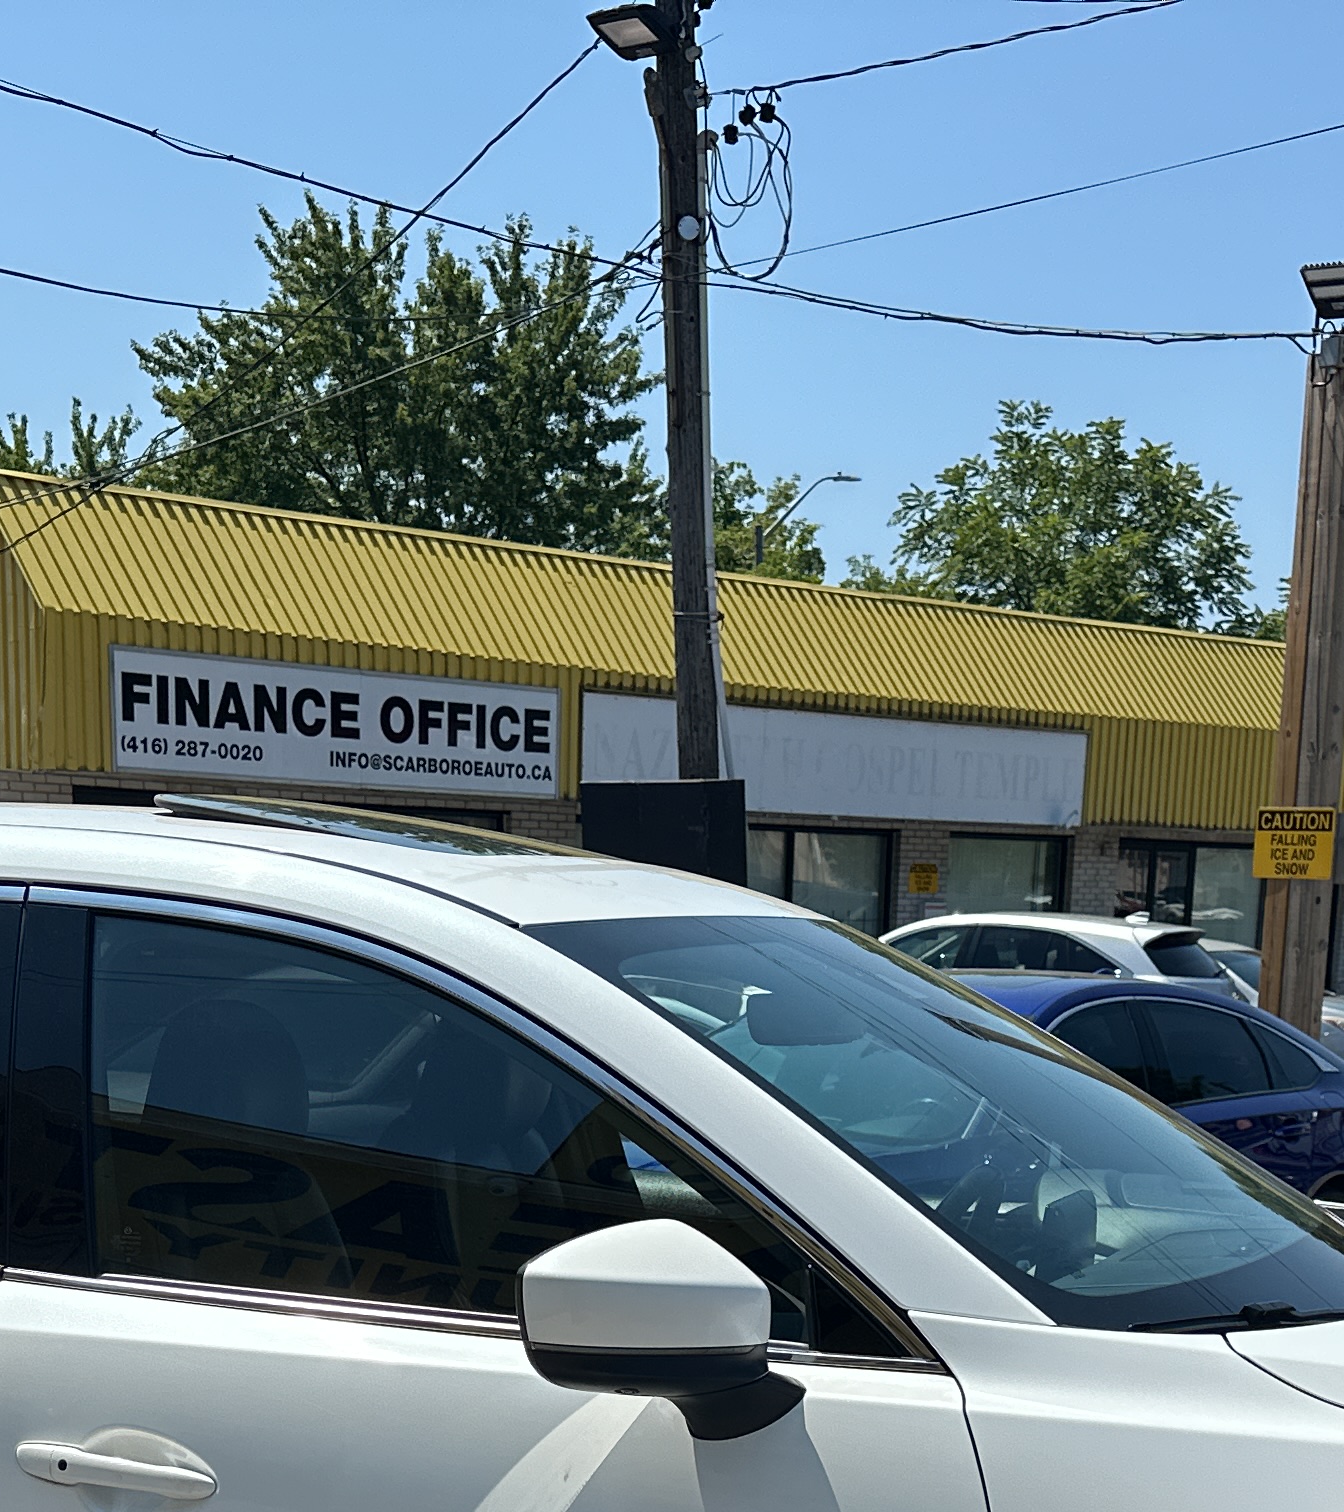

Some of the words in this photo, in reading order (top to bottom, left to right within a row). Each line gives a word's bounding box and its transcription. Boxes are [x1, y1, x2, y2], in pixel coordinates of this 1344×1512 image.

[121, 671, 361, 740] FINANCE
[380, 696, 551, 754] OFFICE
[121, 735, 168, 755] (416)
[175, 740, 263, 762] 287-0020
[329, 751, 552, 782] INFO@SCARBOROEAUTO.CA
[1261, 812, 1330, 830] CAUTION
[1270, 833, 1317, 847] FALLING
[1270, 848, 1288, 861] ICE
[1291, 848, 1315, 861] AND
[1274, 862, 1309, 875] SNOW
